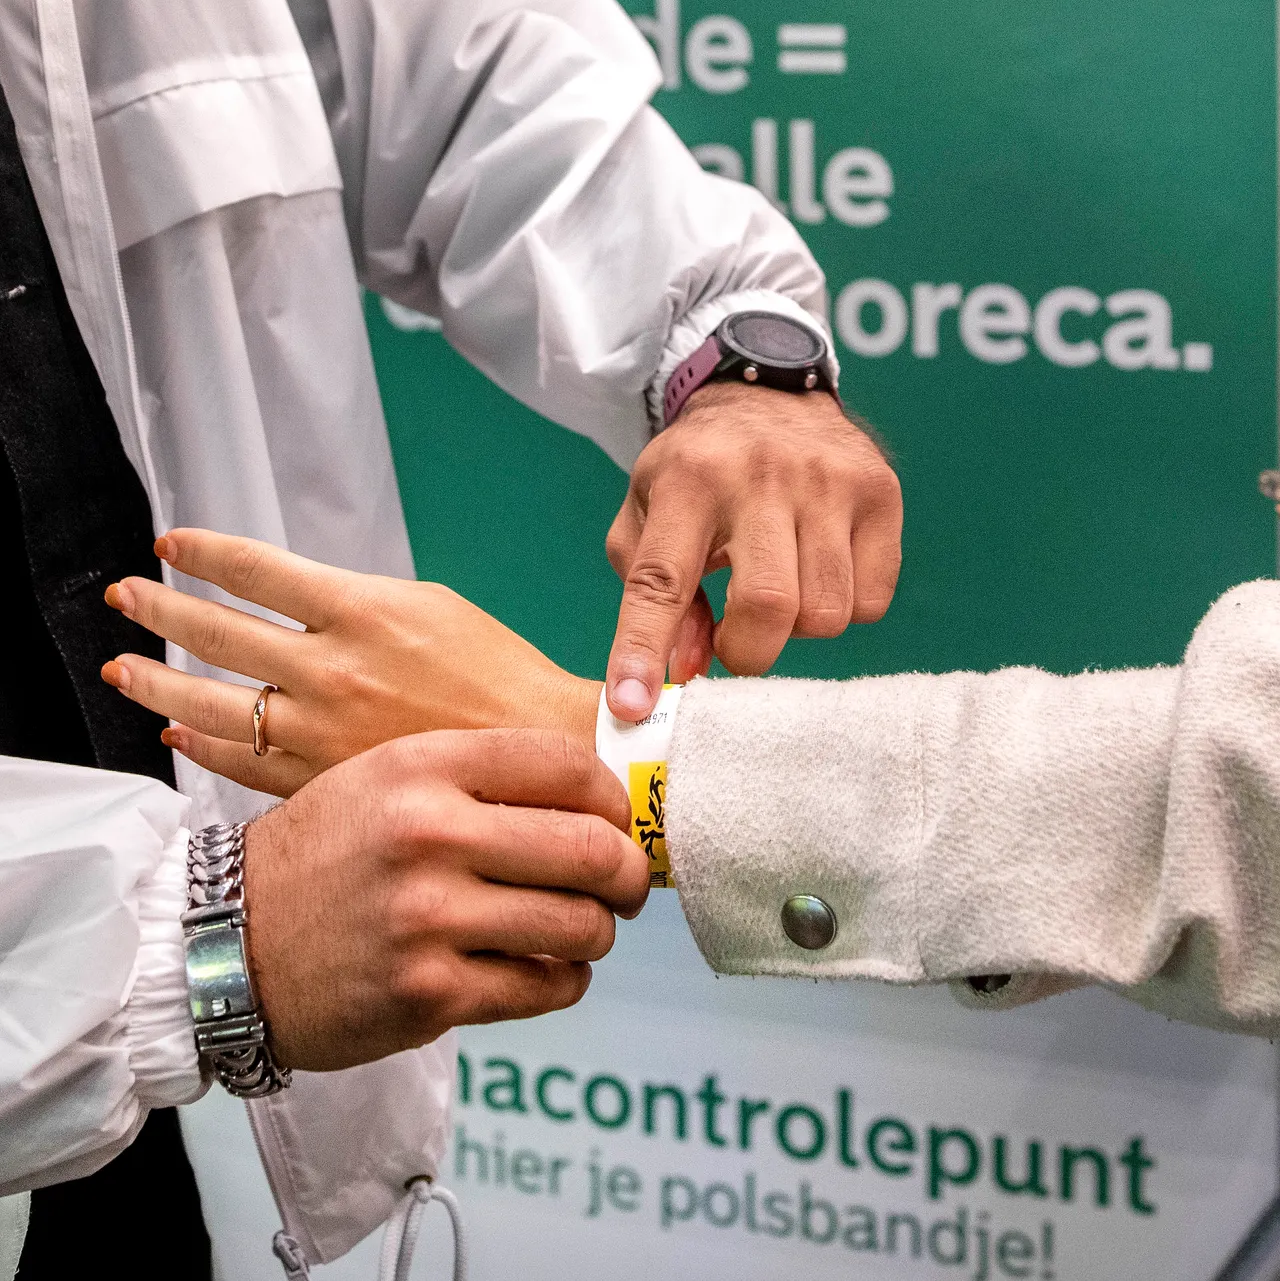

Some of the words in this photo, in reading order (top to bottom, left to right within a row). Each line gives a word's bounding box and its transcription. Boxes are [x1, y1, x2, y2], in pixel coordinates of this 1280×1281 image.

[834, 277, 1214, 373] oreca.
[454, 1124, 571, 1197] hier
[586, 1146, 644, 1220] je
[659, 1173, 1055, 1281] polsbandje!
